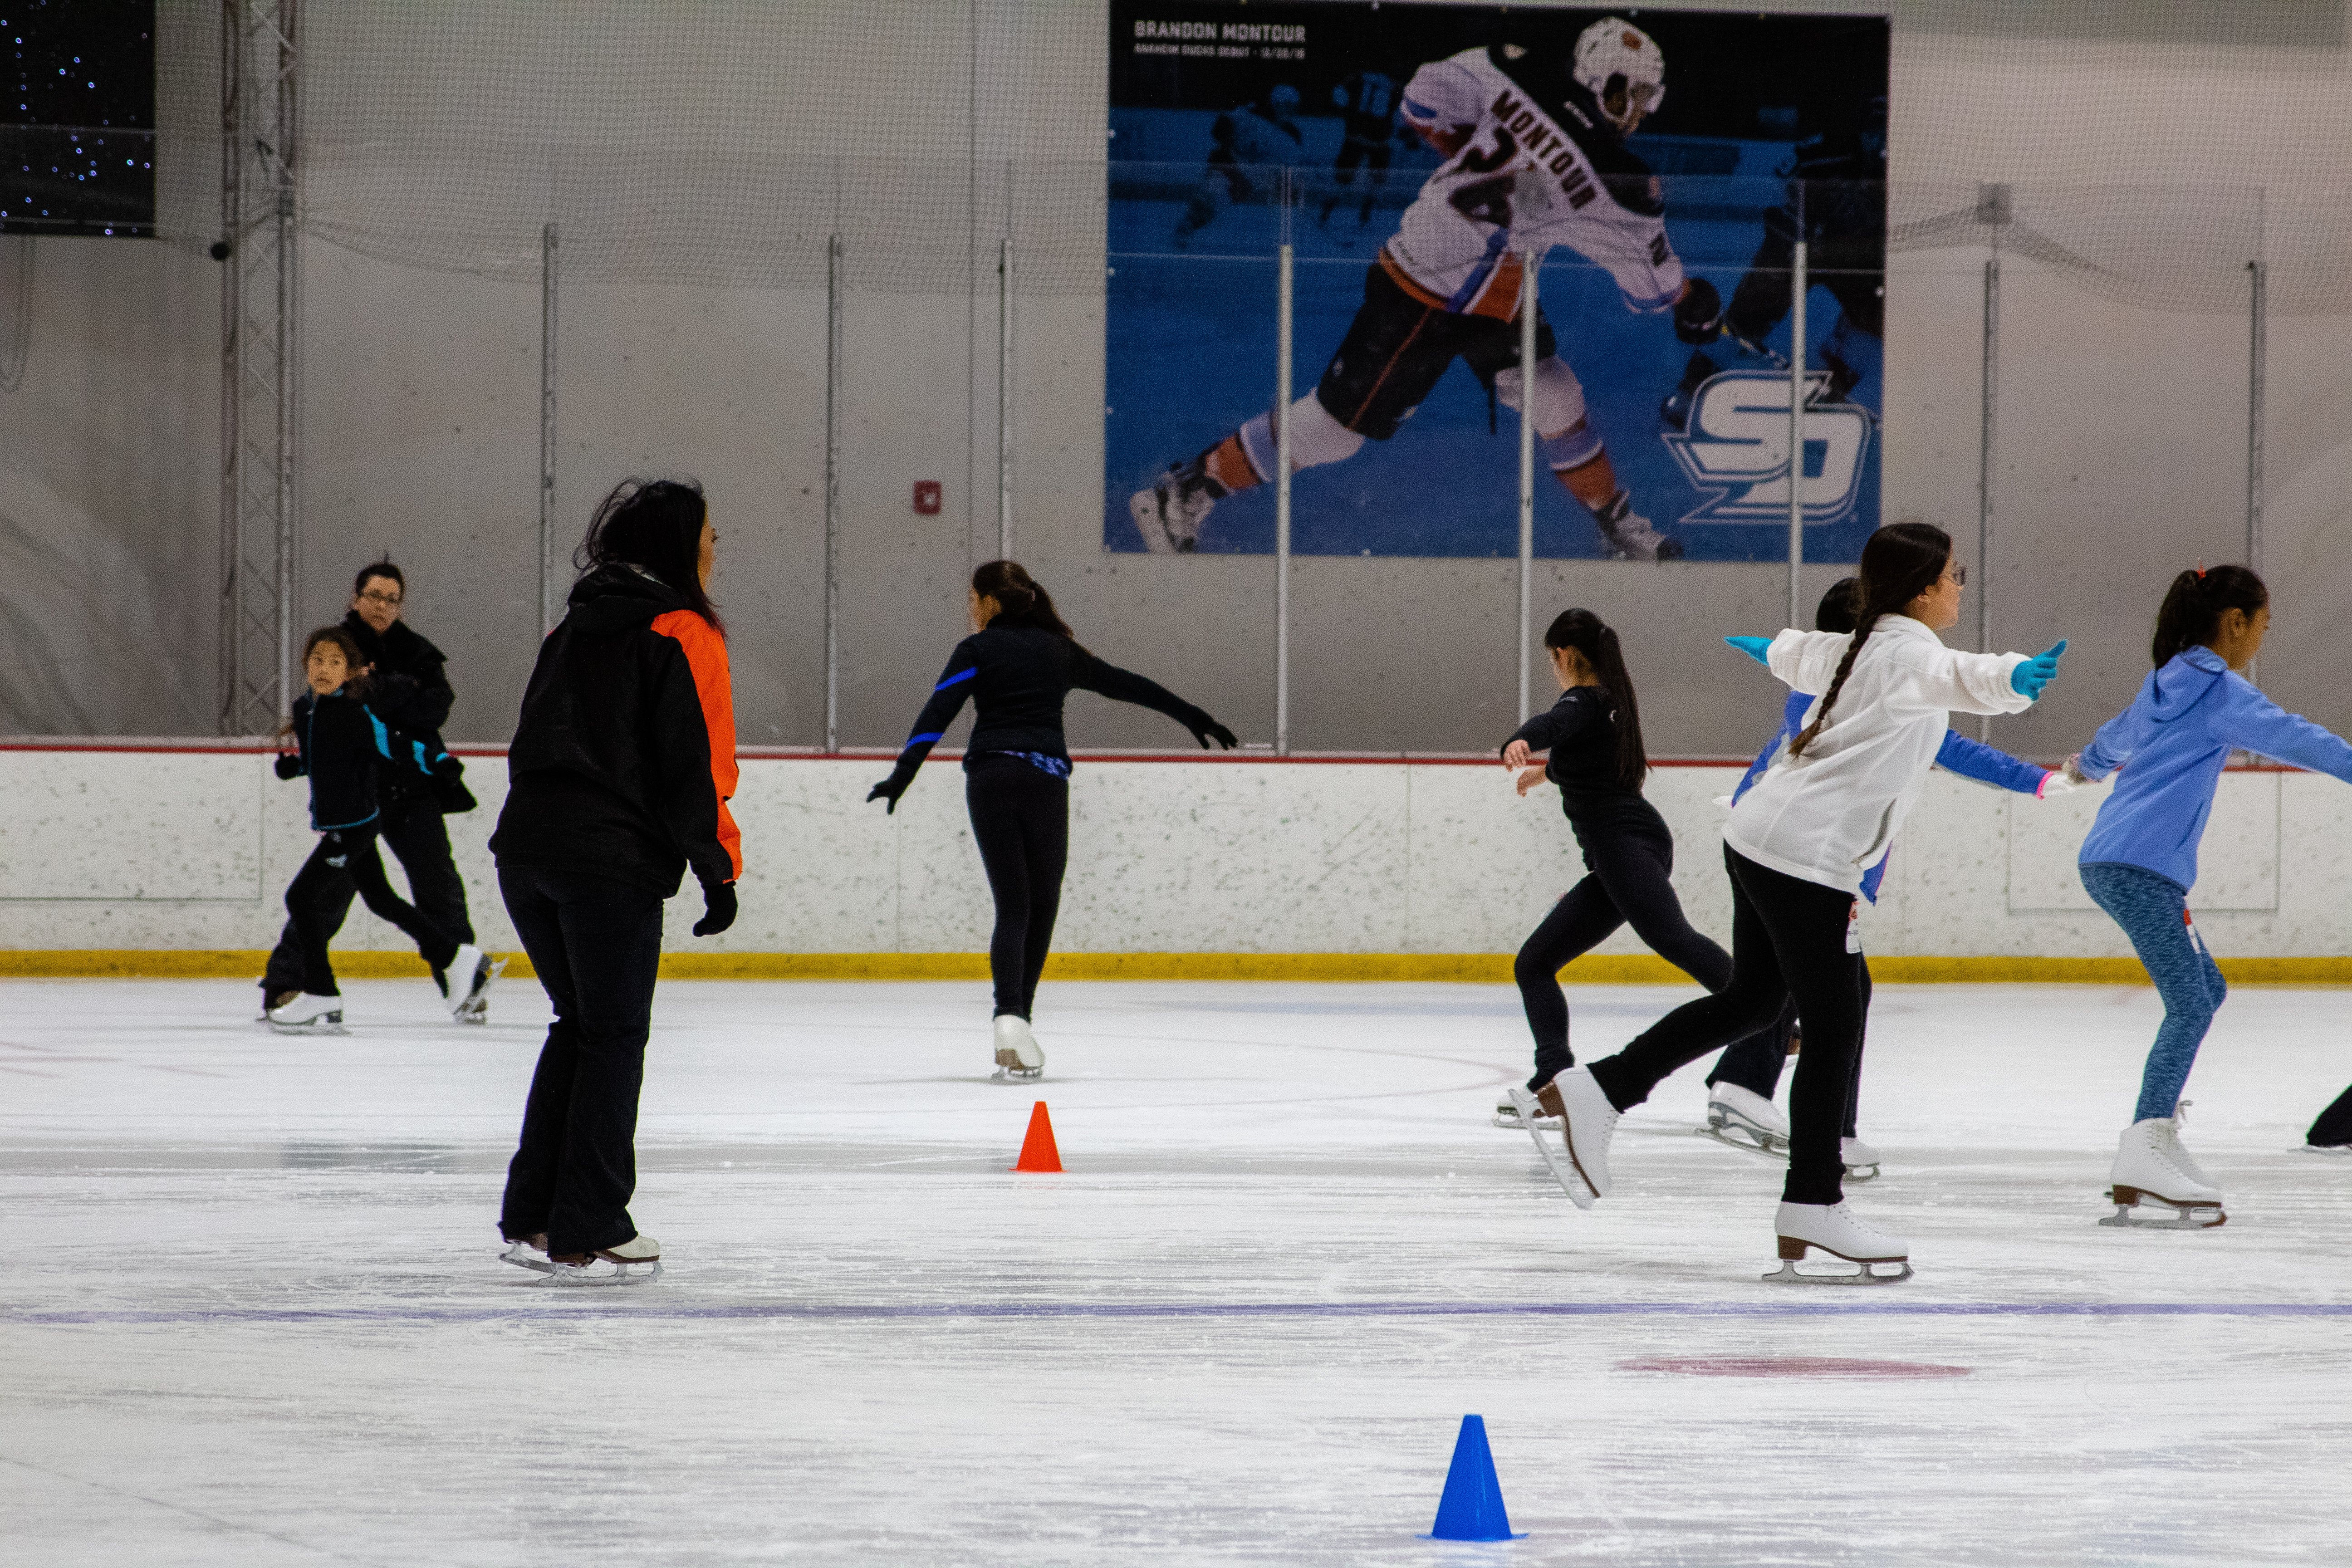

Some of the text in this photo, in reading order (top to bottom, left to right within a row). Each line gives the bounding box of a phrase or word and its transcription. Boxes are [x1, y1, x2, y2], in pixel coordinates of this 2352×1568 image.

[1134, 20, 1306, 43] BRANDON MONTOUR
[1134, 43, 1180, 55] ANAHEIM
[1181, 44, 1216, 56] DUCKS
[1491, 90, 1596, 210] MONTOUR
